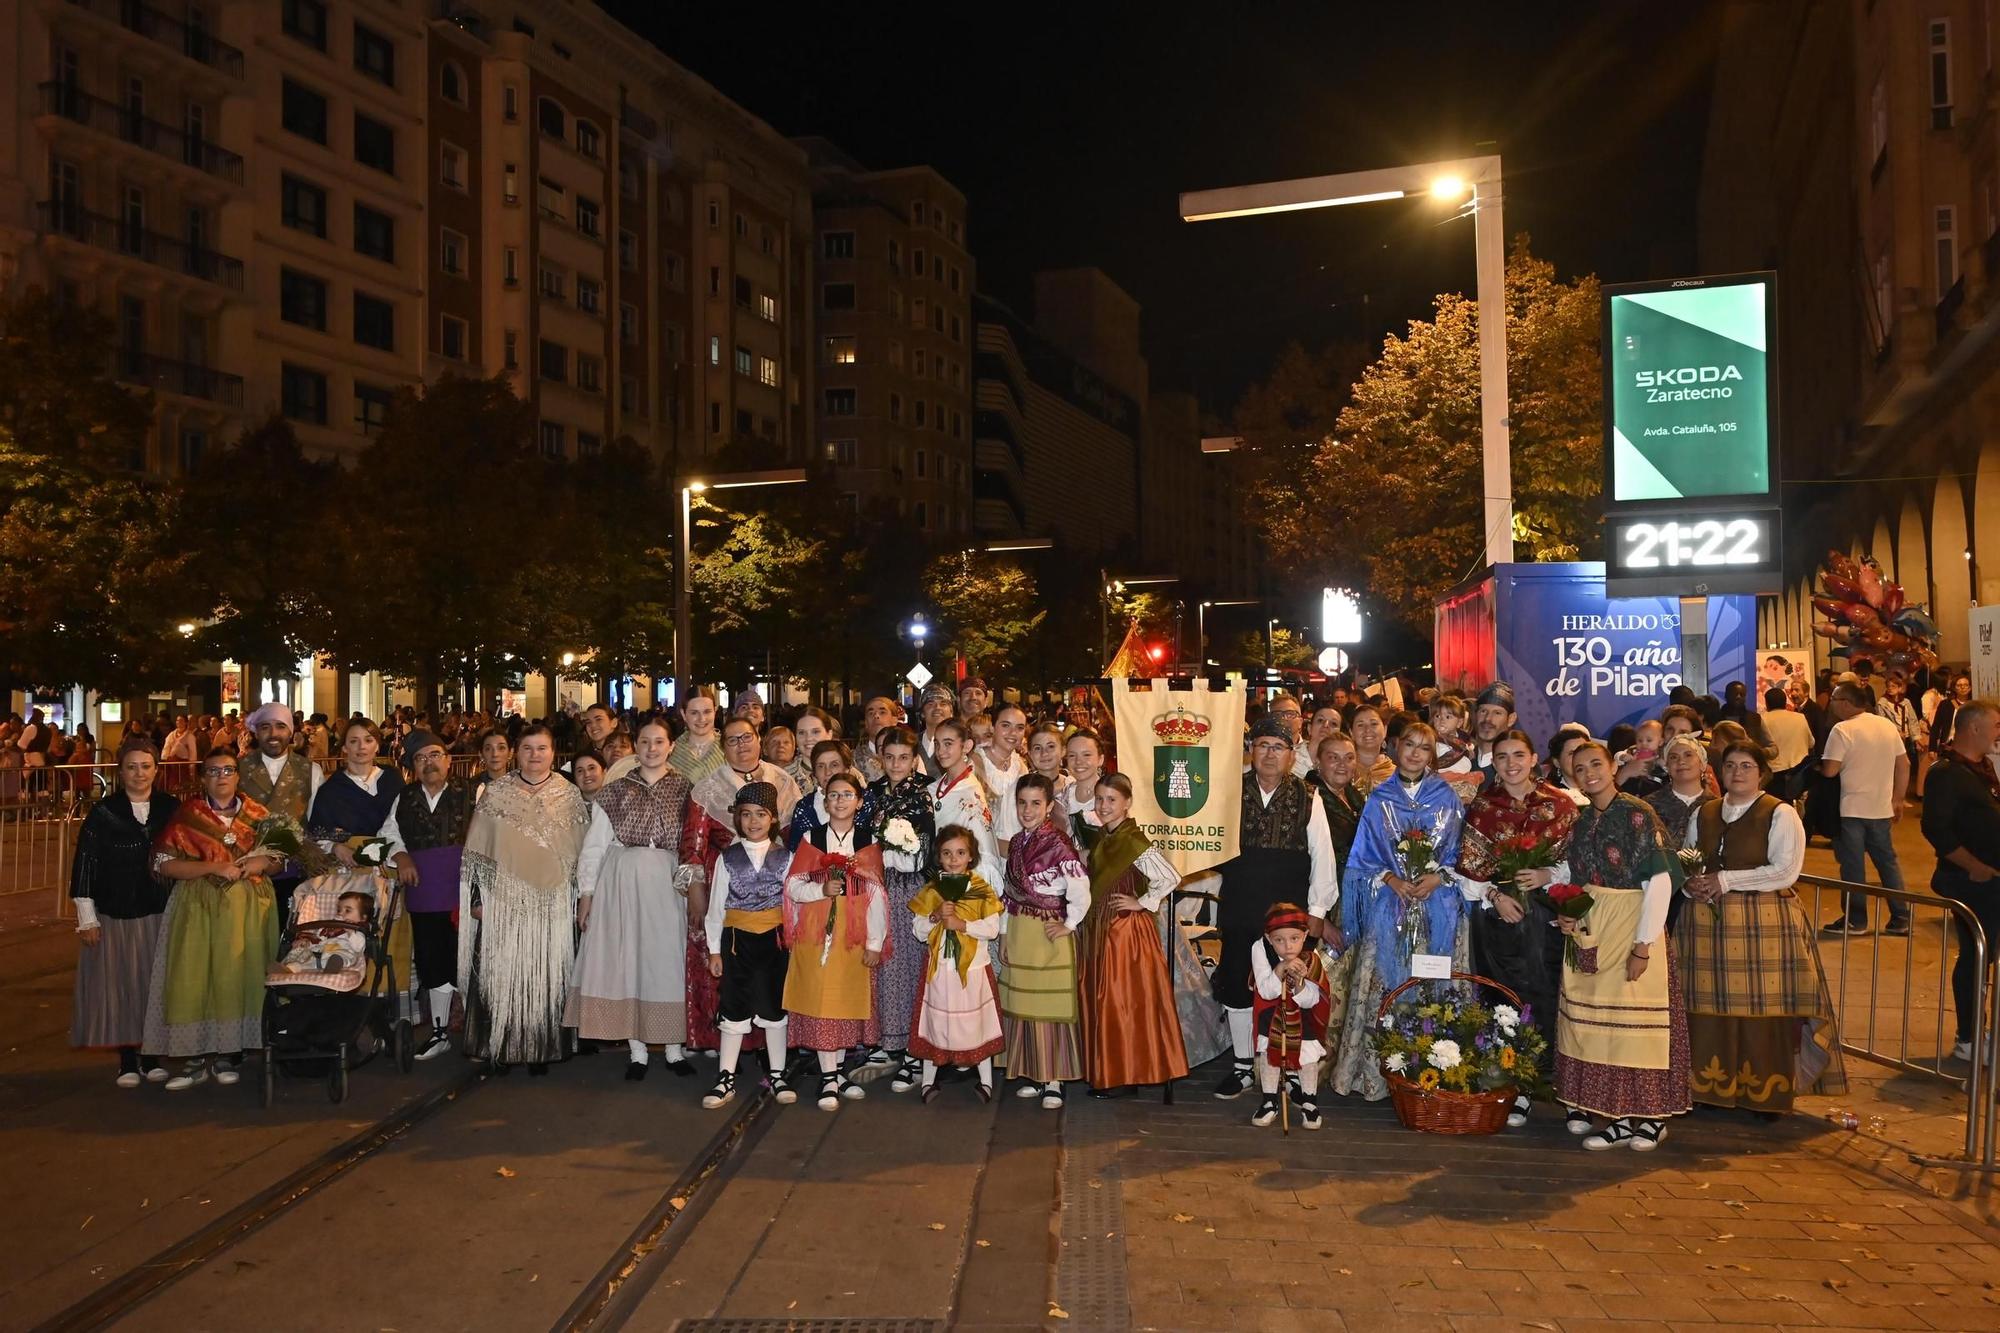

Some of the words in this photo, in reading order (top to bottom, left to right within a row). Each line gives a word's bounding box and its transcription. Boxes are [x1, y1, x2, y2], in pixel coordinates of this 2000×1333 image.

[1646, 387, 1733, 403] Zaratecno
[1643, 427, 1670, 437] Avda.
[1671, 423, 1717, 434] Cataluña,
[1718, 422, 1737, 432] 105
[1625, 519, 1760, 568] 21:22
[1562, 614, 1658, 631] HERALDO
[1552, 636, 1612, 667] 130
[1623, 640, 1682, 667] año
[1545, 667, 1581, 696] de
[1591, 665, 1683, 696] Pilare
[1140, 824, 1204, 836] TORRALBA
[1208, 826, 1225, 837] DE
[1151, 839, 1165, 850] OS
[1168, 840, 1222, 852] SISONES
